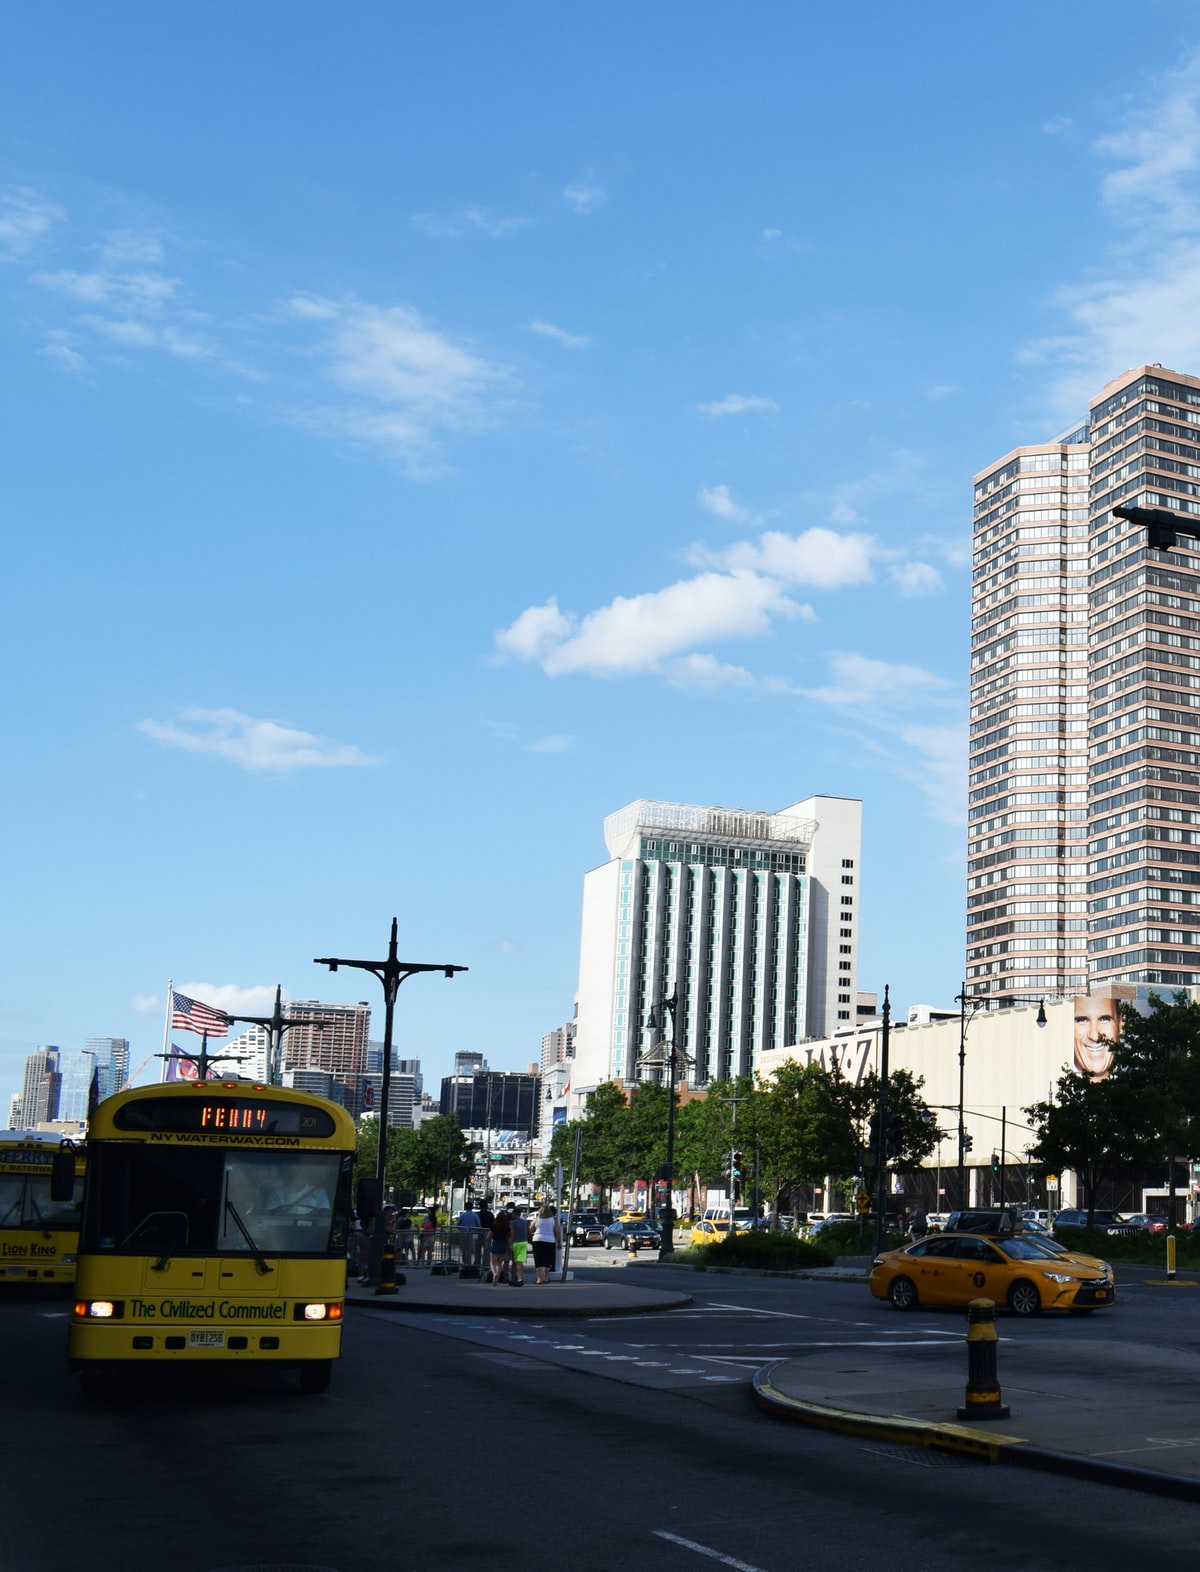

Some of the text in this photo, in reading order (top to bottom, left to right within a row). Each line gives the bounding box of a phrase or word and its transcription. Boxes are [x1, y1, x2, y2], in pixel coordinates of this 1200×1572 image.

[302, 1117, 318, 1128] 201
[151, 1133, 300, 1146] NY WATERWAY.COM
[131, 1300, 287, 1319] The Civilized Commute!
